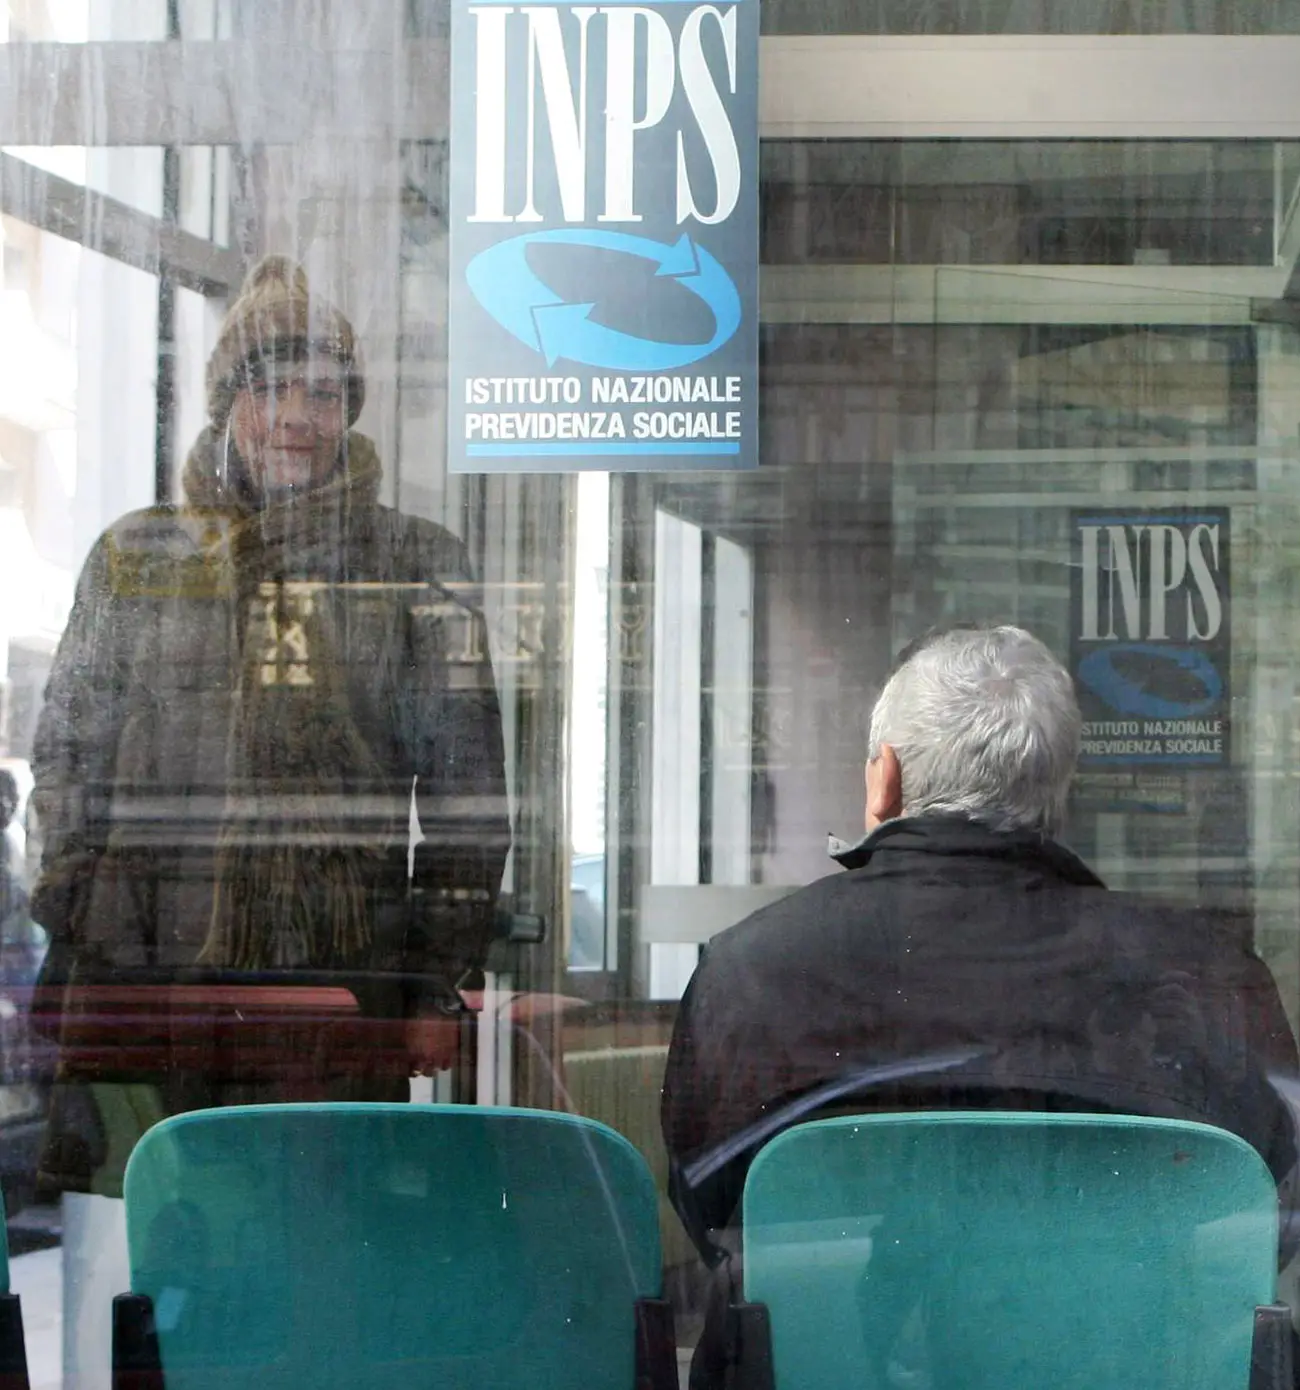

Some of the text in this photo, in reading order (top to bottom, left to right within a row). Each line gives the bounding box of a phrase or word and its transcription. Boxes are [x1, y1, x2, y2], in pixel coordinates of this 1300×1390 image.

[466, 4, 741, 225] INPS
[465, 376, 740, 404] ISTITUTO NAZIONALE
[465, 412, 741, 439] PREVIDENZA SOCIALE
[1079, 524, 1222, 641] INPS
[1081, 720, 1222, 736] STITUTO NAZIONALE
[1166, 739, 1223, 753] SOCIALE
